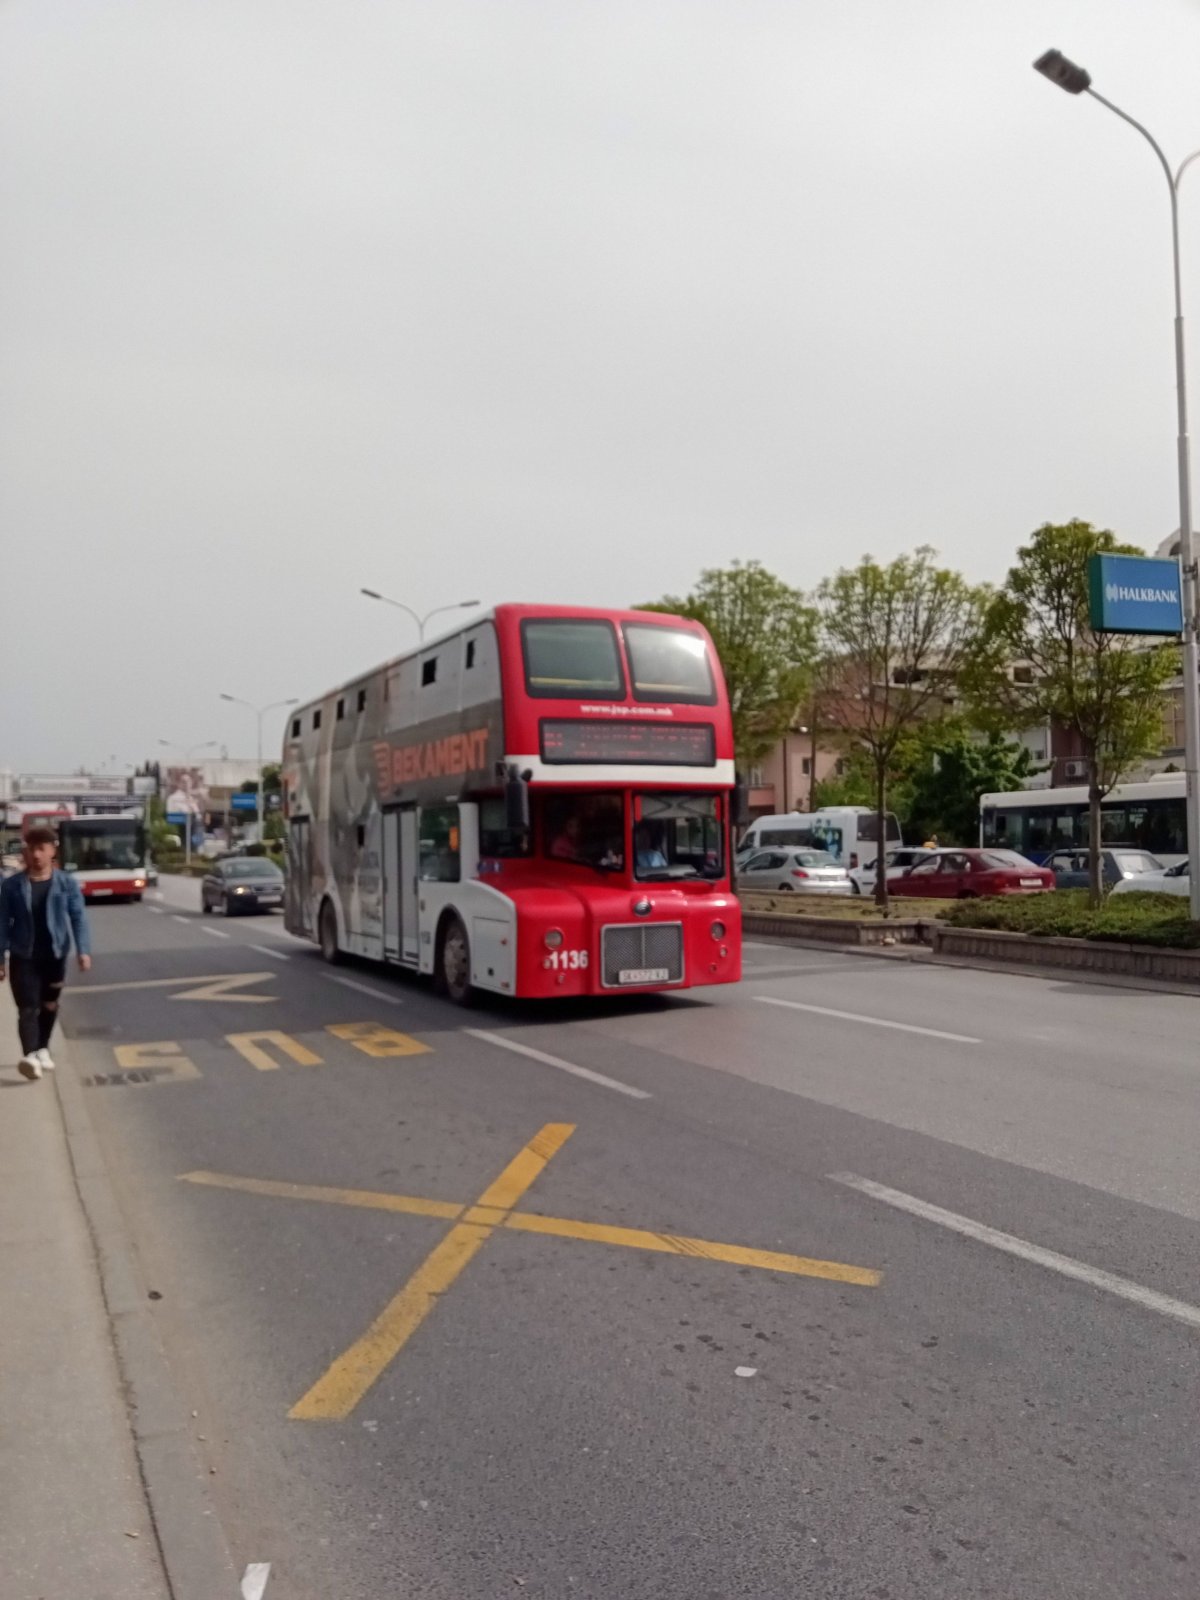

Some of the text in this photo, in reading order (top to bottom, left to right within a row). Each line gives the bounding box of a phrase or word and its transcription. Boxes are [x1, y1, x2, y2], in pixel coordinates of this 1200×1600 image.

[1119, 587, 1177, 603] HALKBANK
[392, 728, 488, 783] BEKAMENT
[549, 949, 589, 970] 1136
